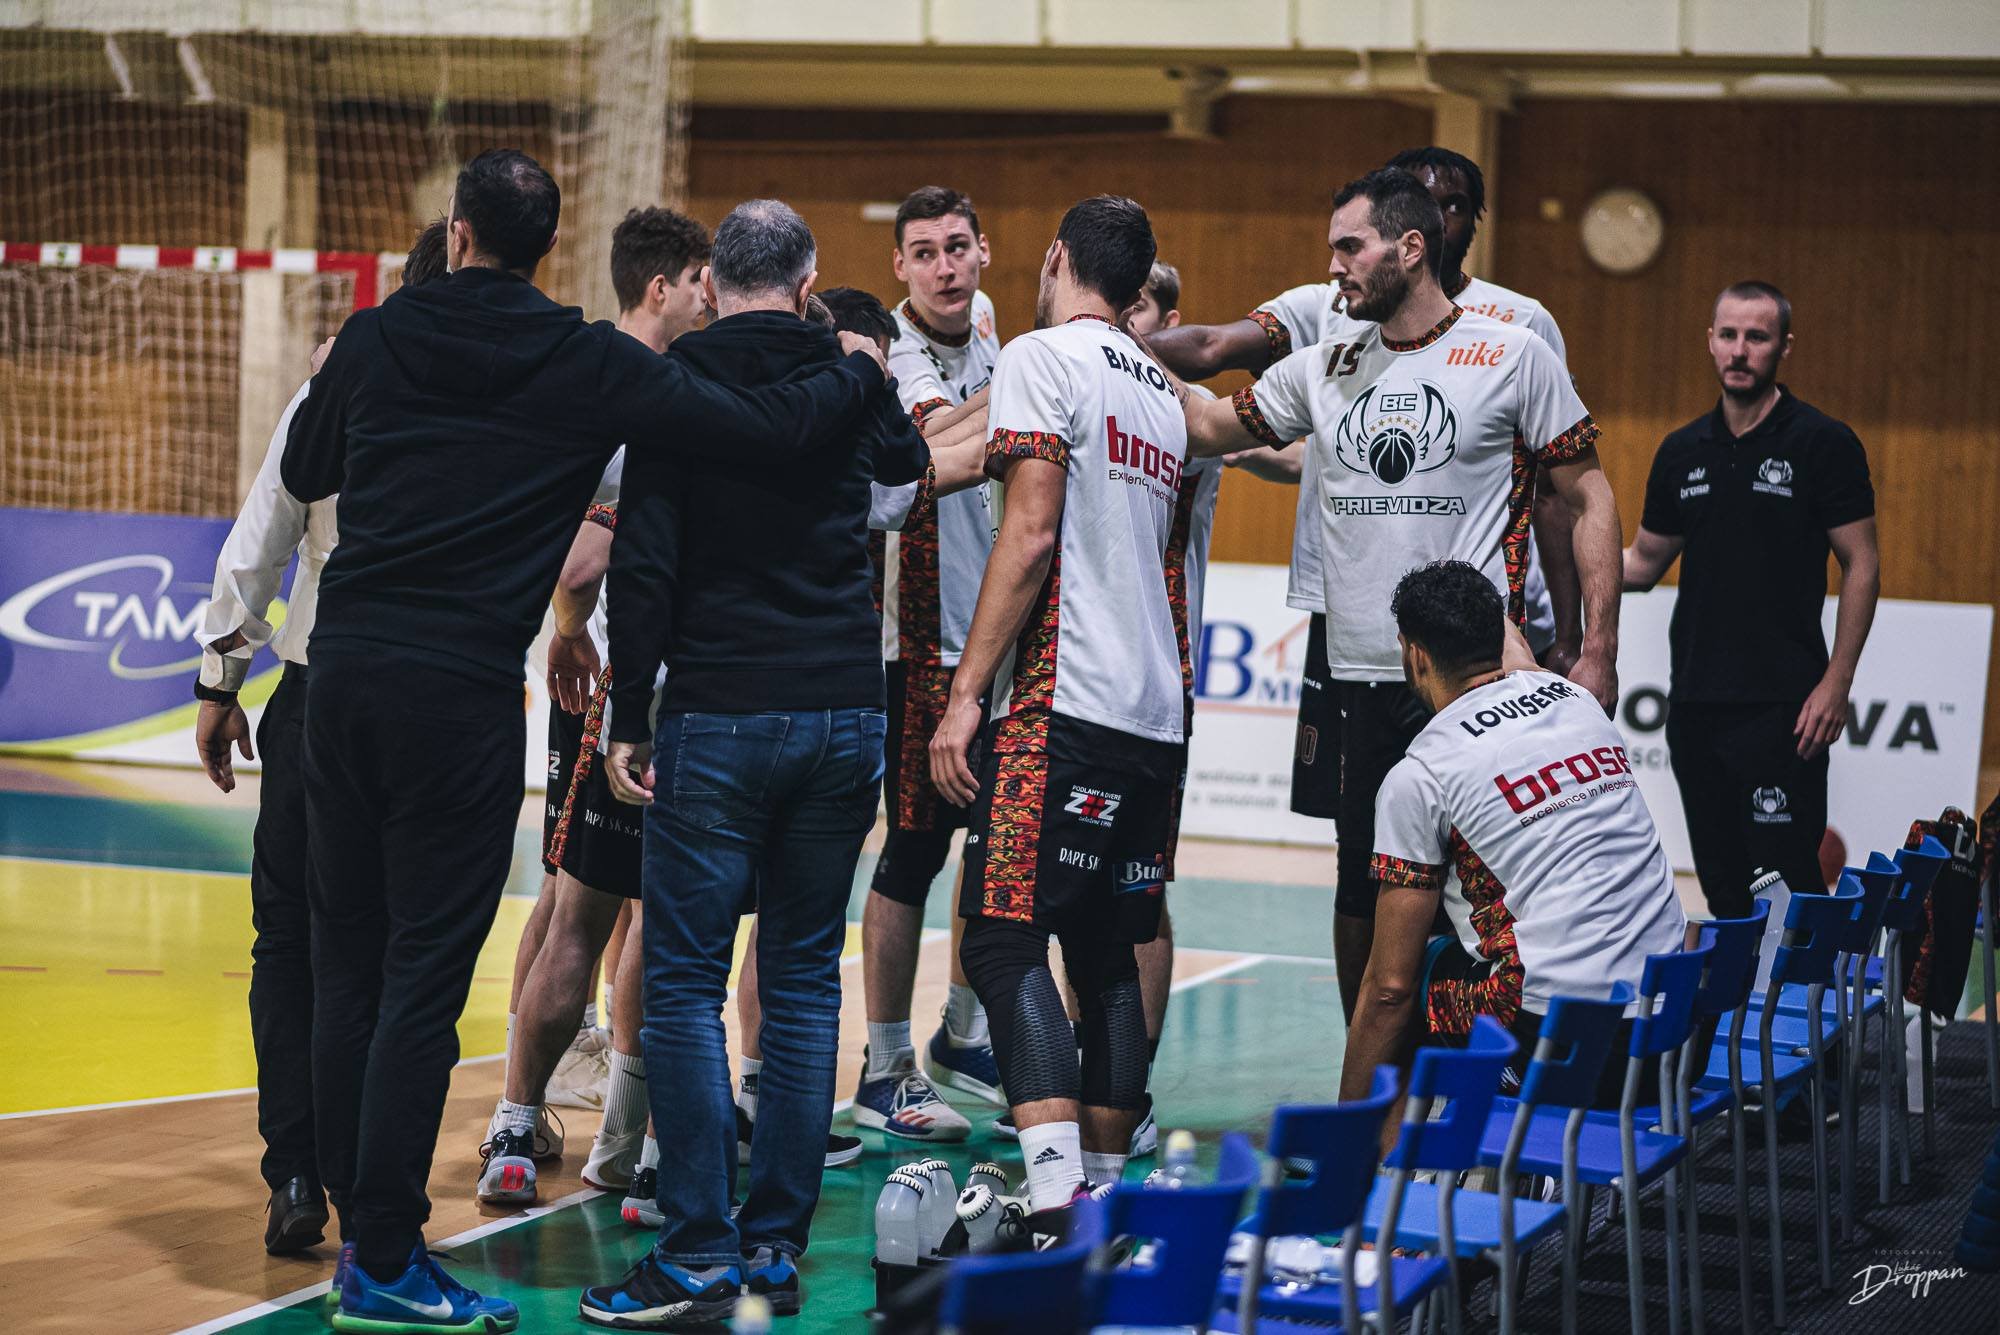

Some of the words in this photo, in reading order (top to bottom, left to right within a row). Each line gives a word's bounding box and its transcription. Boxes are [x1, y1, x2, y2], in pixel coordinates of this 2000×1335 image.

[1446, 341, 1506, 367] niké
[1380, 394, 1418, 412] BC
[1330, 496, 1466, 515] PRIEVIDZA
[1520, 792, 1587, 828] Excellence
[1059, 847, 1086, 868] DAPE
[1033, 1154, 1065, 1166] adidas
